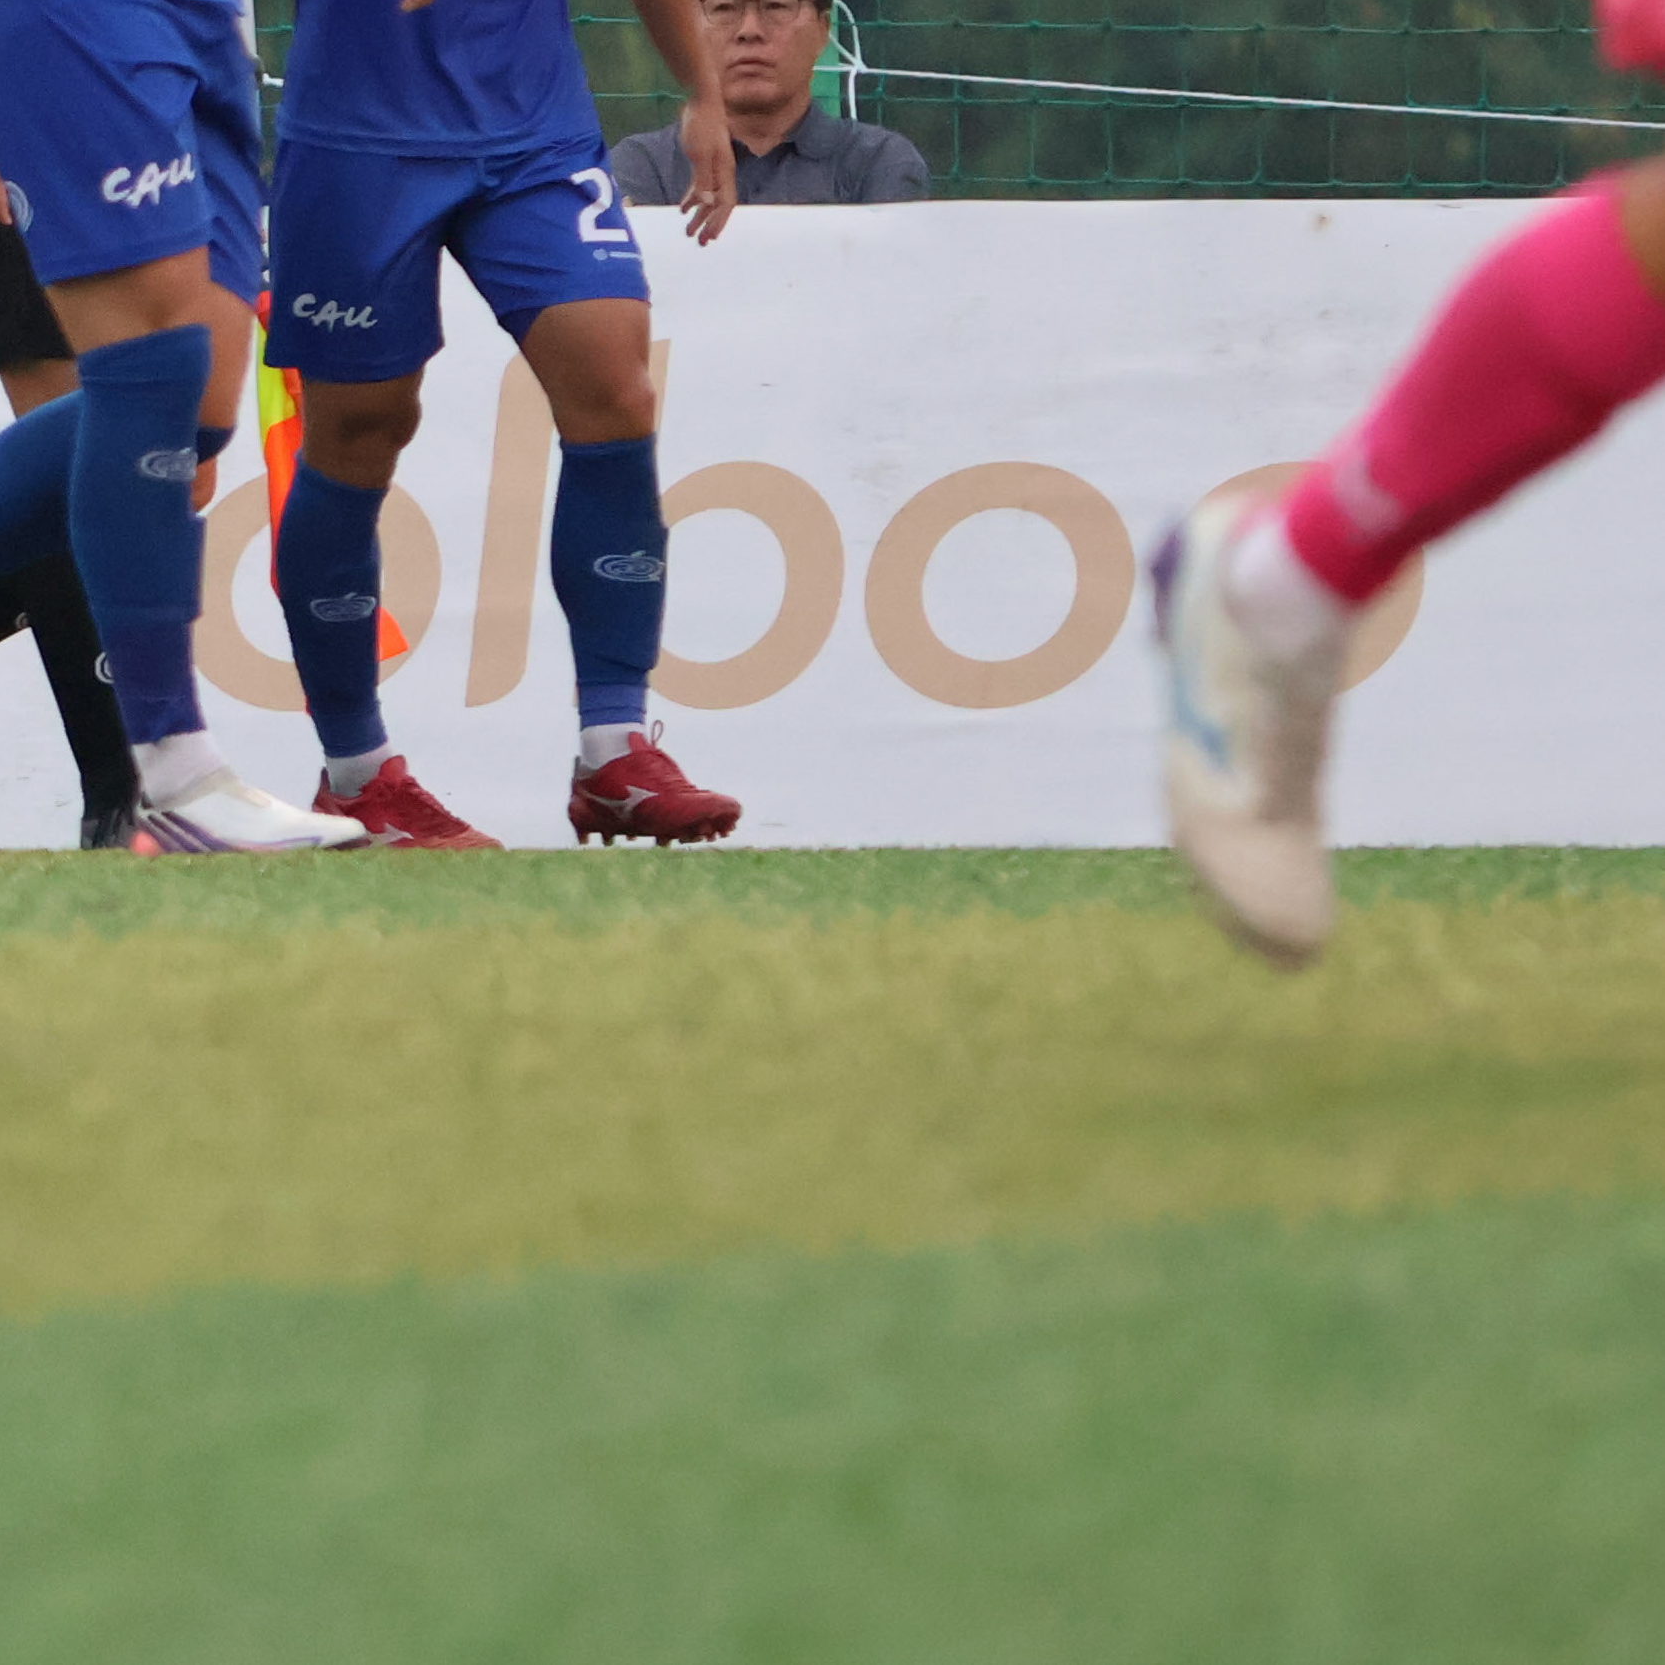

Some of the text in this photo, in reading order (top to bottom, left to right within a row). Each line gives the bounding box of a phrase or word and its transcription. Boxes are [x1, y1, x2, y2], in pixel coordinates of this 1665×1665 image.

[101, 152, 196, 208] CAU
[570, 167, 630, 243] 2
[292, 292, 379, 333] CAU
